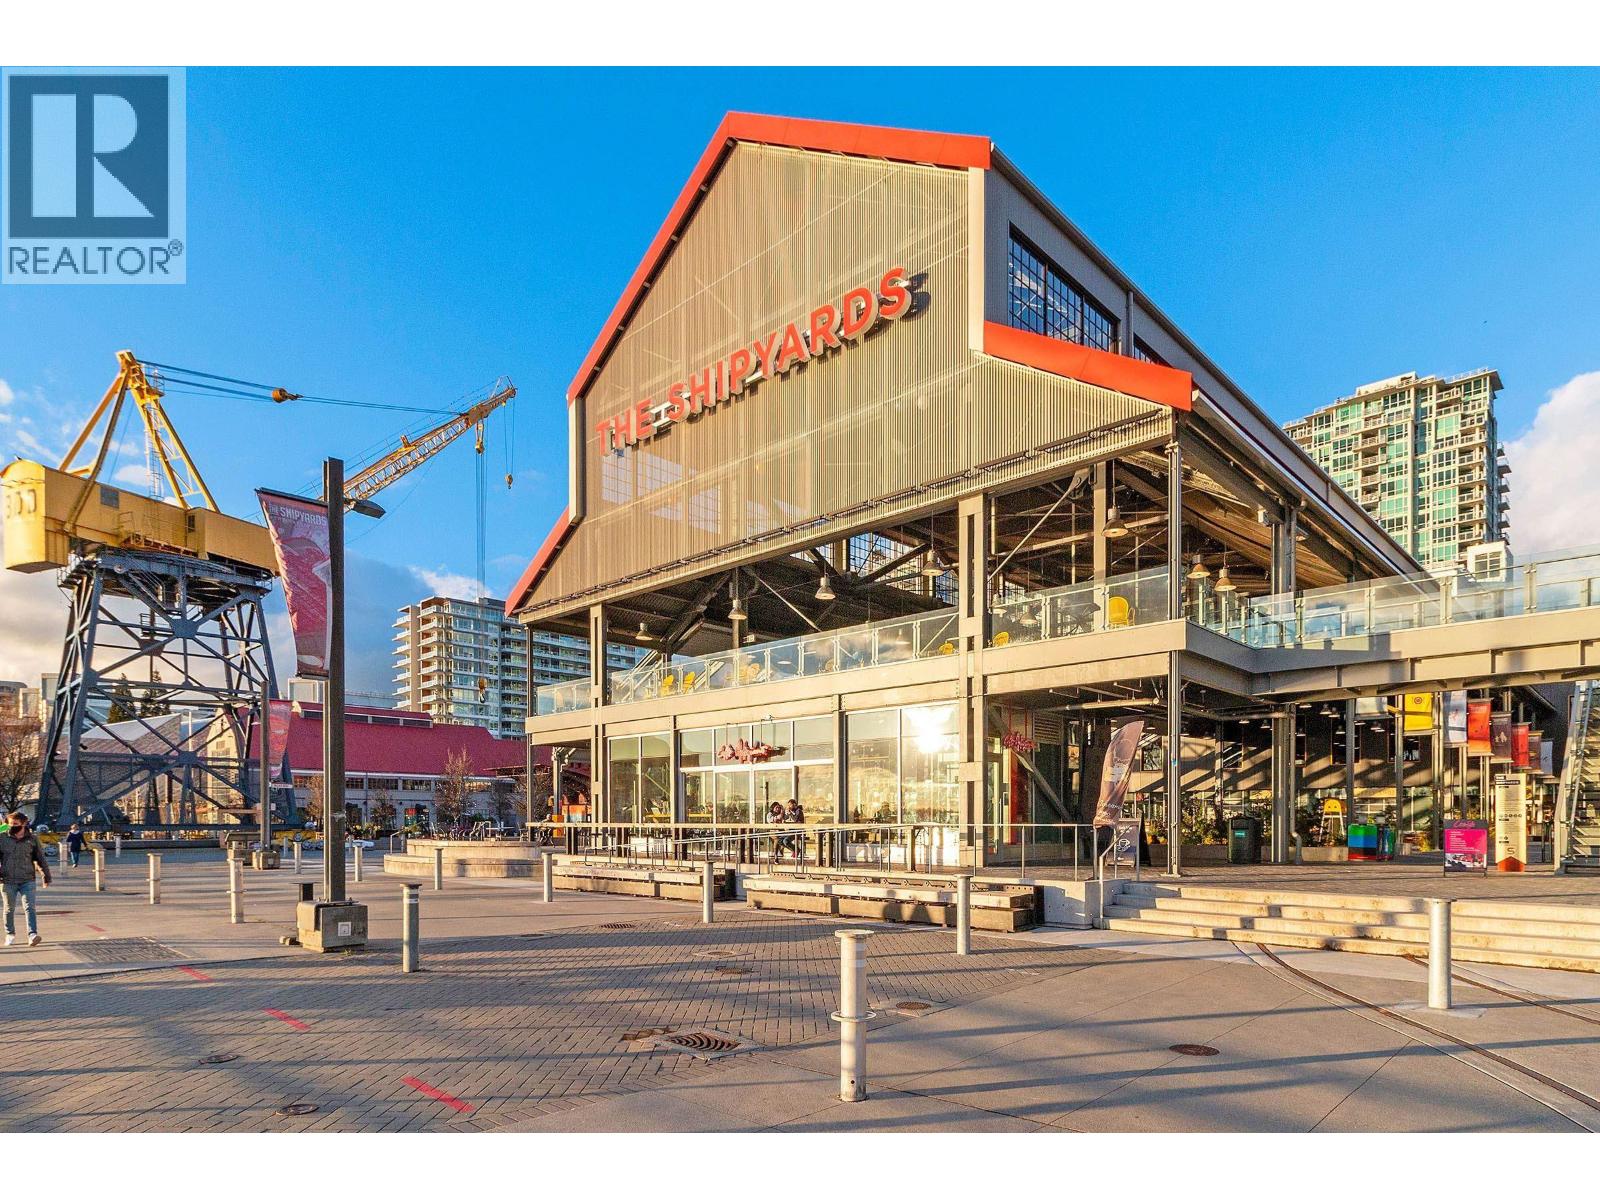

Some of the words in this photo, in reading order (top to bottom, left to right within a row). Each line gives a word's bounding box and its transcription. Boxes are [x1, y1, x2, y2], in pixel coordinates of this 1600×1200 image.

[595, 399, 655, 457] THE
[666, 266, 913, 423] SHIPYARDS
[280, 506, 327, 526] SHIPYARDS
